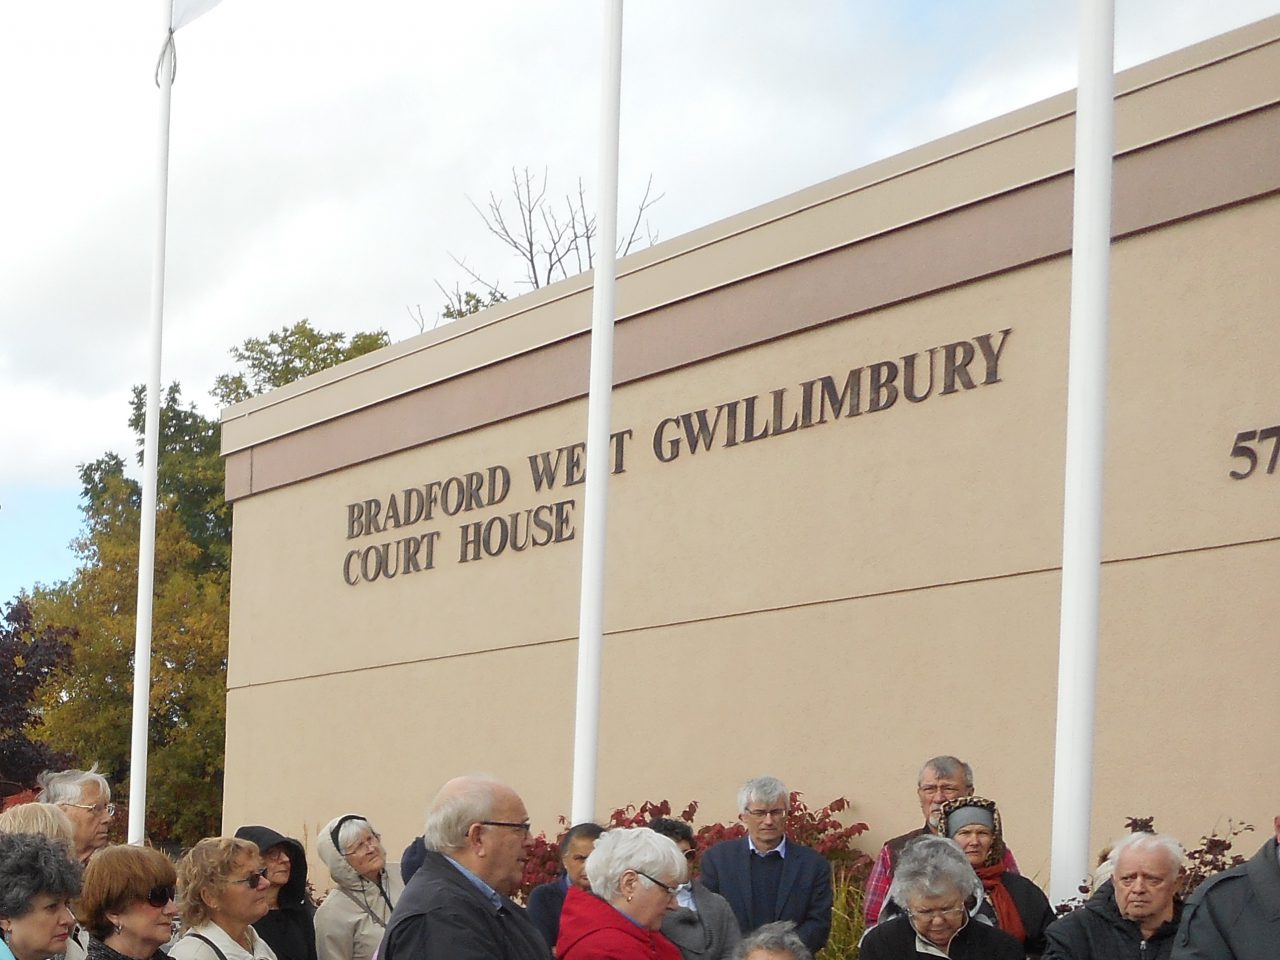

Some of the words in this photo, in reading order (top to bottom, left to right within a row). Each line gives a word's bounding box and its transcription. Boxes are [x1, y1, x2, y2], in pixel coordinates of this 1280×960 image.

[346, 465, 511, 540] BRADFORD
[528, 429, 632, 492] WET
[653, 328, 1012, 463] GWILLIMBURY
[1229, 425, 1280, 480] 57
[343, 531, 440, 585] COURT
[458, 500, 575, 564] HOUSE
